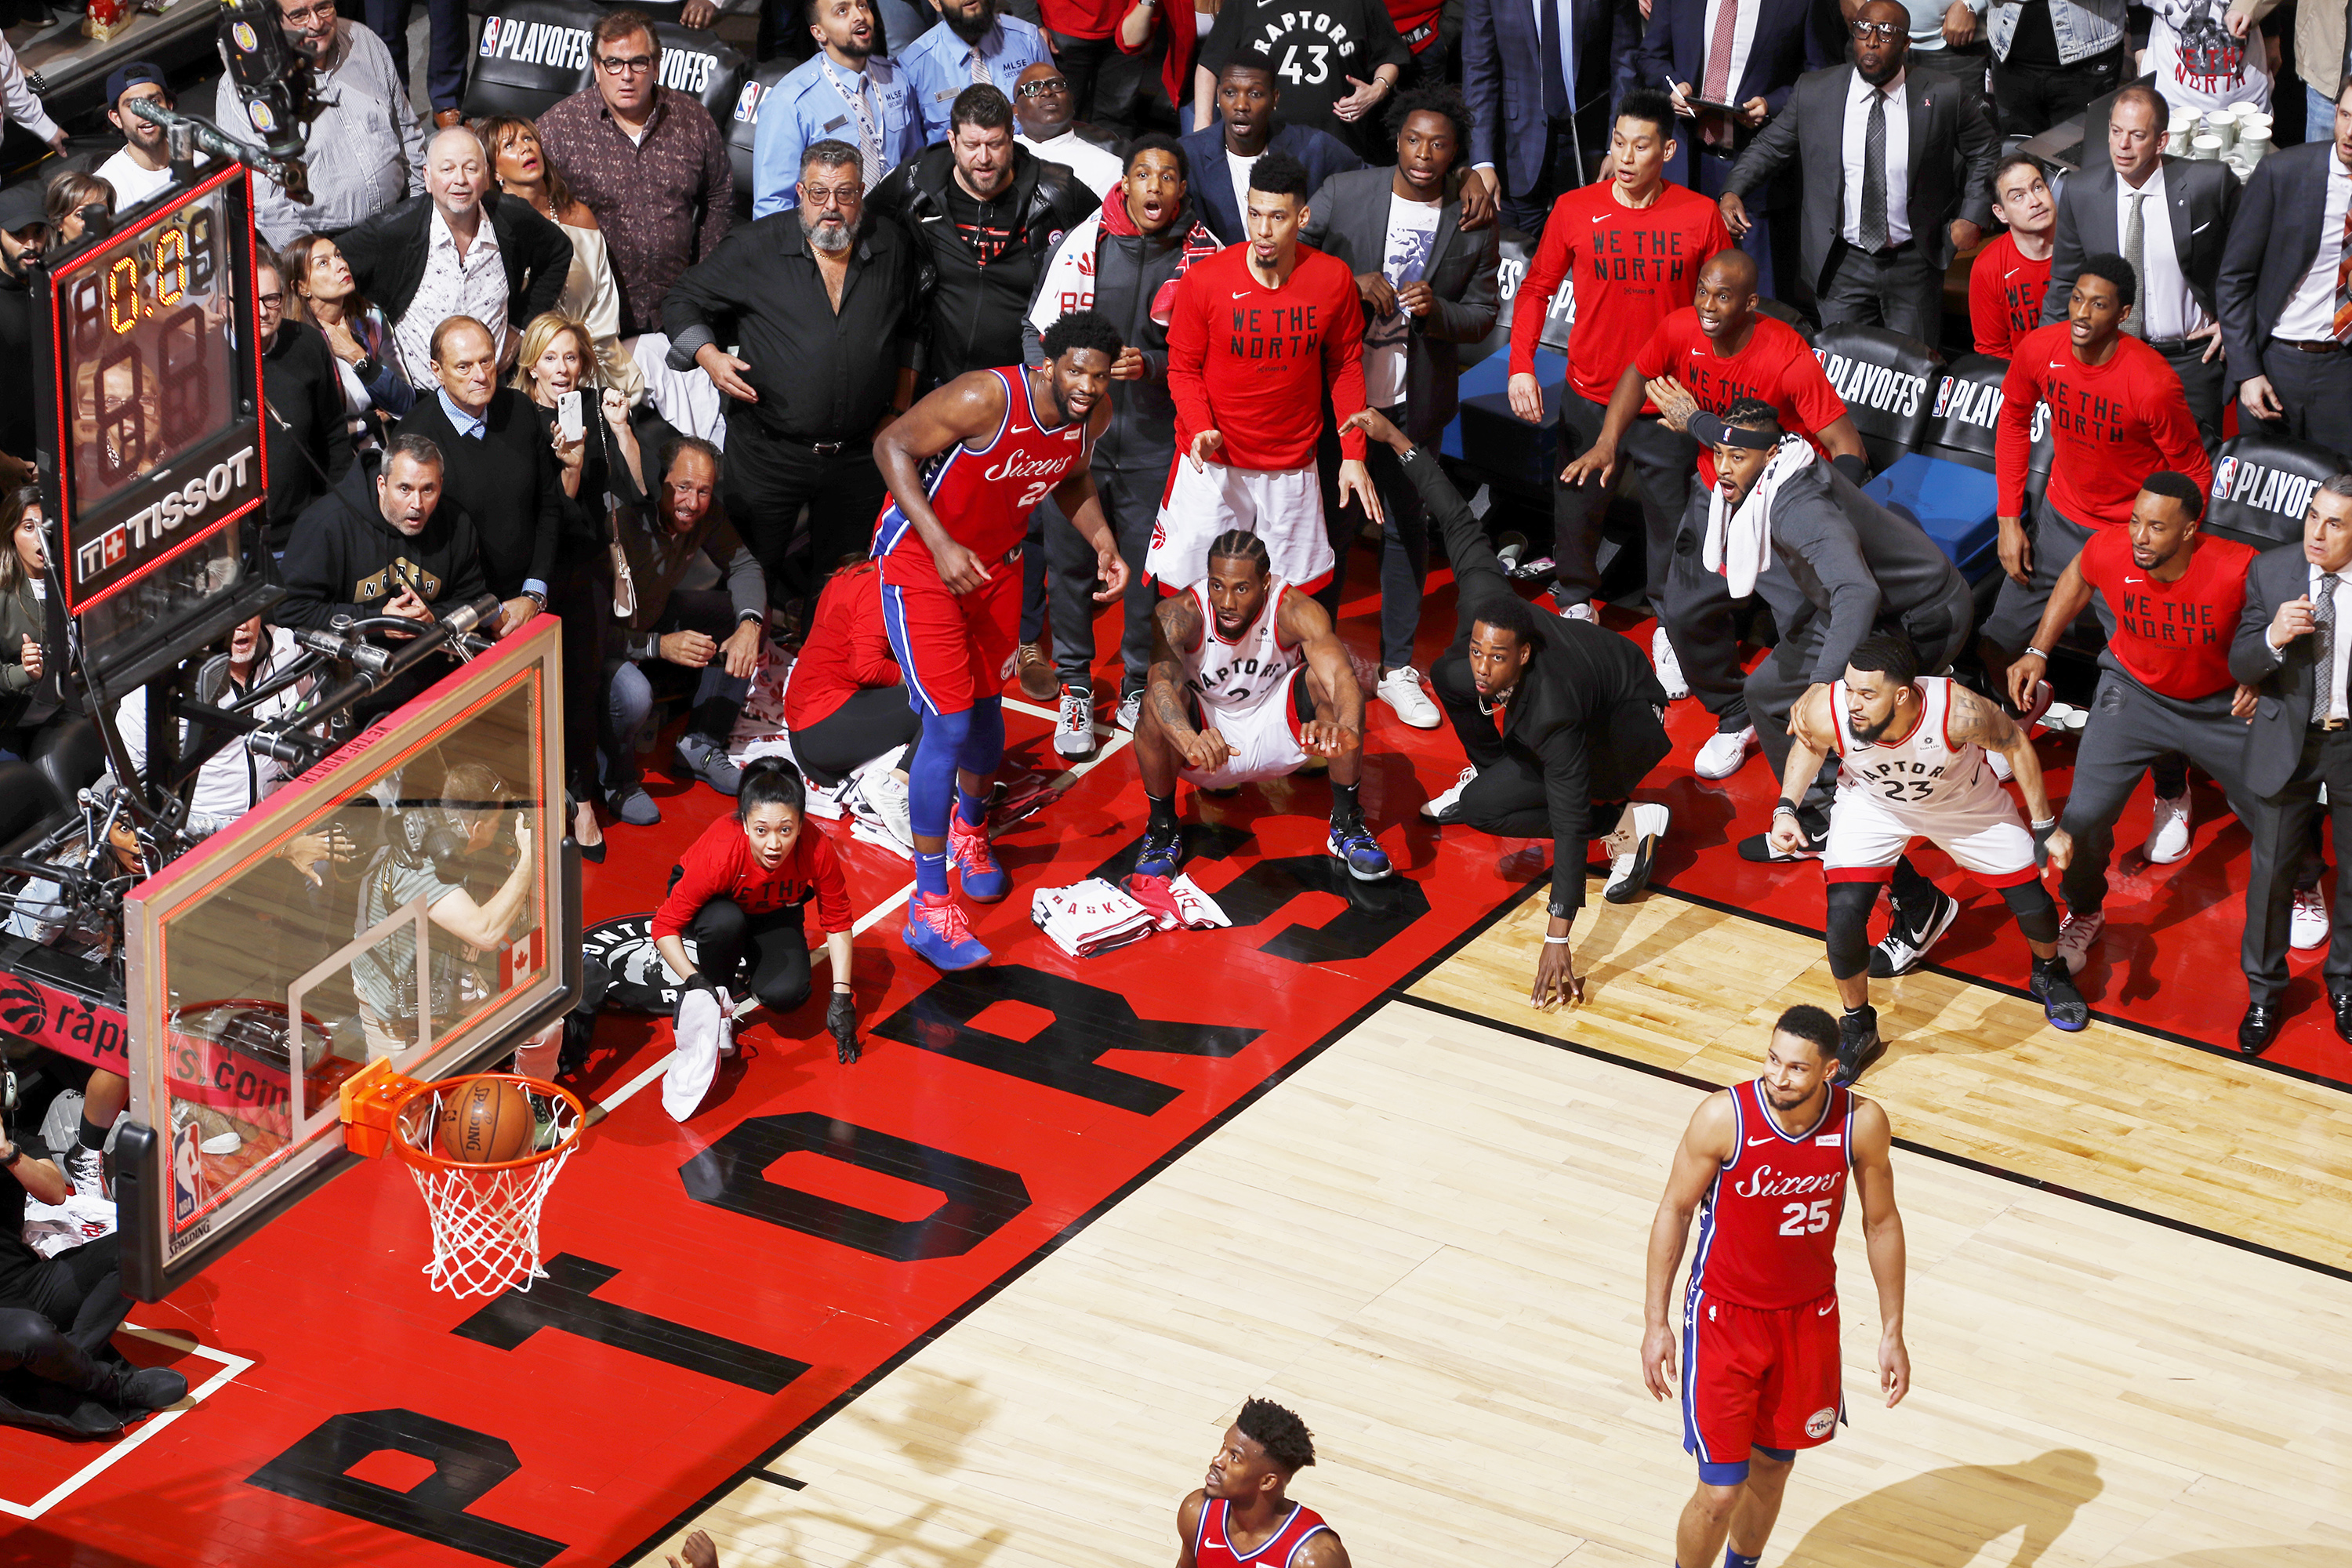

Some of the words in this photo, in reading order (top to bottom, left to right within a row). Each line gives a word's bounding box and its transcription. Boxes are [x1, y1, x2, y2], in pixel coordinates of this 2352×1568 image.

[495, 19, 593, 71] PLAYOFFS
[1254, 10, 1355, 56] RAPTORS
[654, 47, 718, 93] YOFFS
[1003, 59, 1027, 71] MLSE
[1278, 45, 1329, 85] 43
[2175, 63, 2246, 93] NORTH
[841, 89, 851, 100] MLSE
[885, 89, 902, 101] MLSE
[1593, 230, 1622, 255] WE
[1633, 230, 1682, 256] THE
[1594, 258, 1684, 281] NORTH
[2005, 283, 2034, 308] WE
[1233, 307, 1261, 332] WE
[1272, 306, 1317, 332] THE
[1231, 333, 1318, 358] NORTH
[1690, 362, 1710, 394] WE
[1825, 354, 1927, 417] PLAYOFFS
[2047, 375, 2069, 405] WE
[2079, 390, 2124, 424] THE
[984, 448, 1072, 481] Sixers
[126, 445, 253, 549] TISSOT
[2231, 461, 2323, 521] PLAYOF
[2123, 590, 2151, 615] WE
[2164, 601, 2214, 625] THE
[2123, 615, 2217, 644] NORTH
[1184, 657, 1281, 694] RAPTORS
[342, 738, 375, 754] THE
[368, 725, 392, 737] WE
[298, 754, 349, 784] NORTH
[1863, 760, 1944, 780] APTOR
[1882, 780, 1933, 802] 23
[762, 879, 808, 899] THE
[466, 1087, 491, 1152] SPALDING
[1735, 1164, 1841, 1197] Sixers
[179, 1196, 192, 1217] NBA
[1779, 1198, 1832, 1236] 25
[169, 1220, 210, 1258] SPALDING
